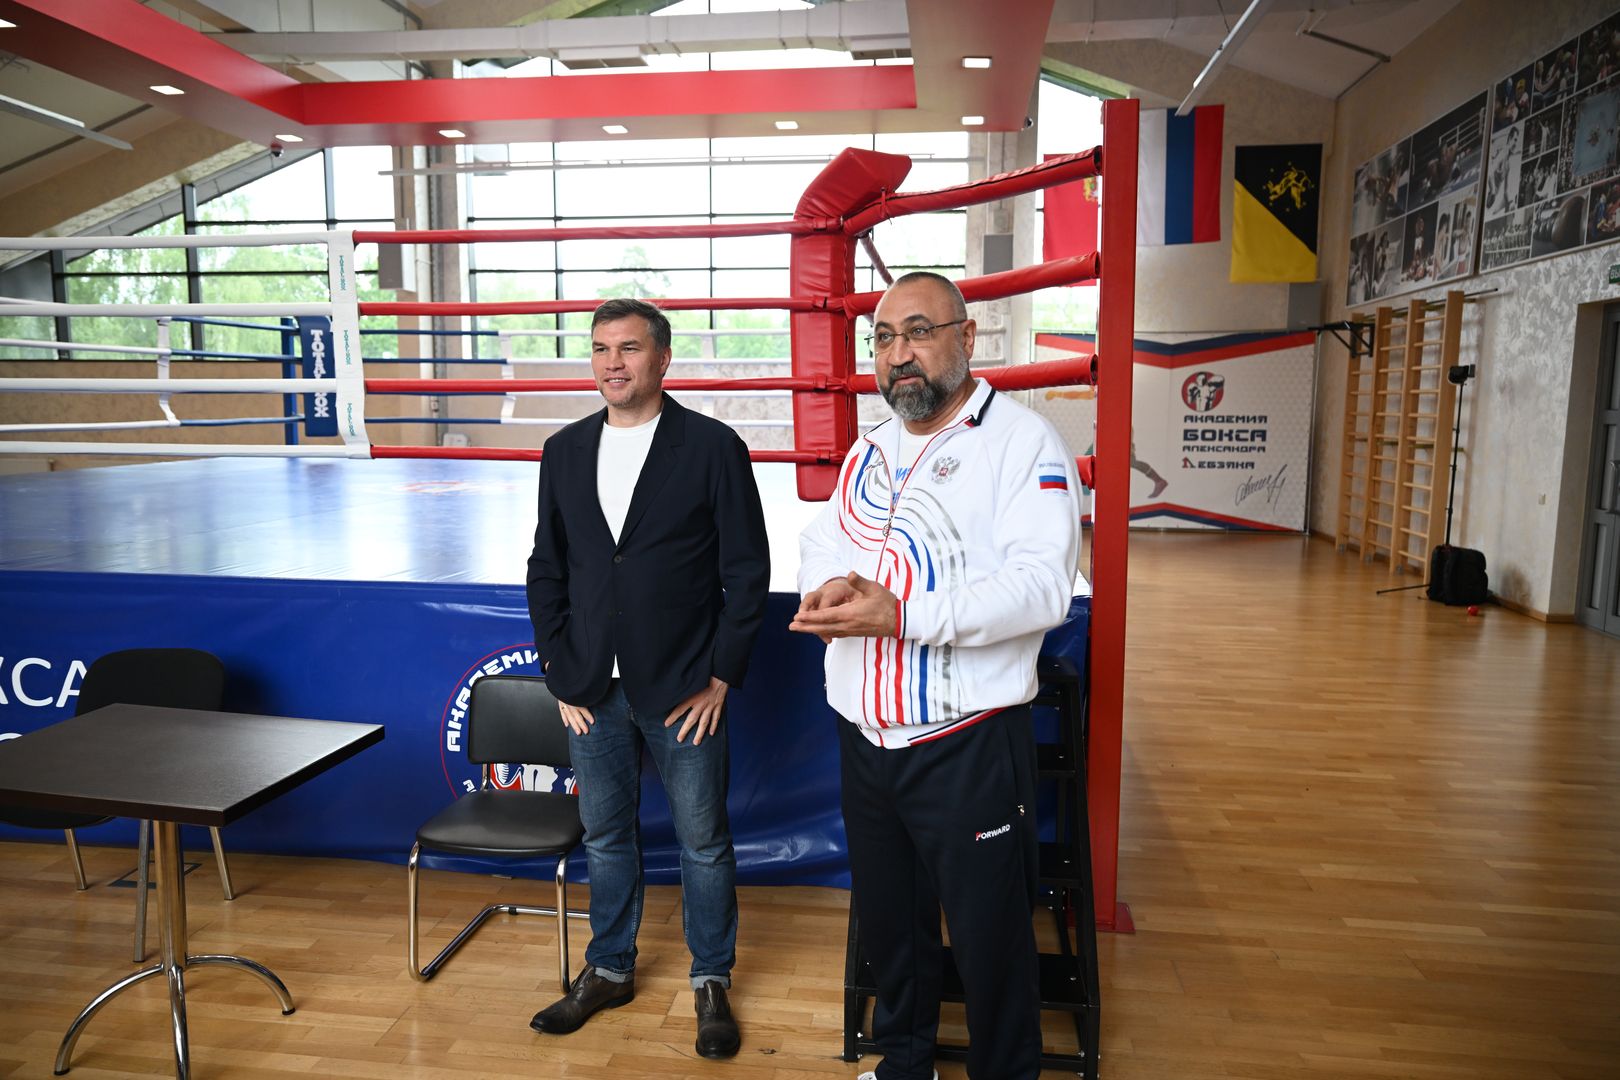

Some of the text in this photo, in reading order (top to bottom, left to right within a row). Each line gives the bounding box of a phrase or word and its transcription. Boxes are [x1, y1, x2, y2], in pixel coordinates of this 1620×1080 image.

[310, 329, 330, 418] TOTAOX
[1184, 415, 1268, 424] АКАДЕМИЯ
[1183, 429, 1267, 442] БОКСА
[1182, 445, 1266, 453] АЛЕКСАНДРА
[975, 824, 1011, 841] FORWARD
